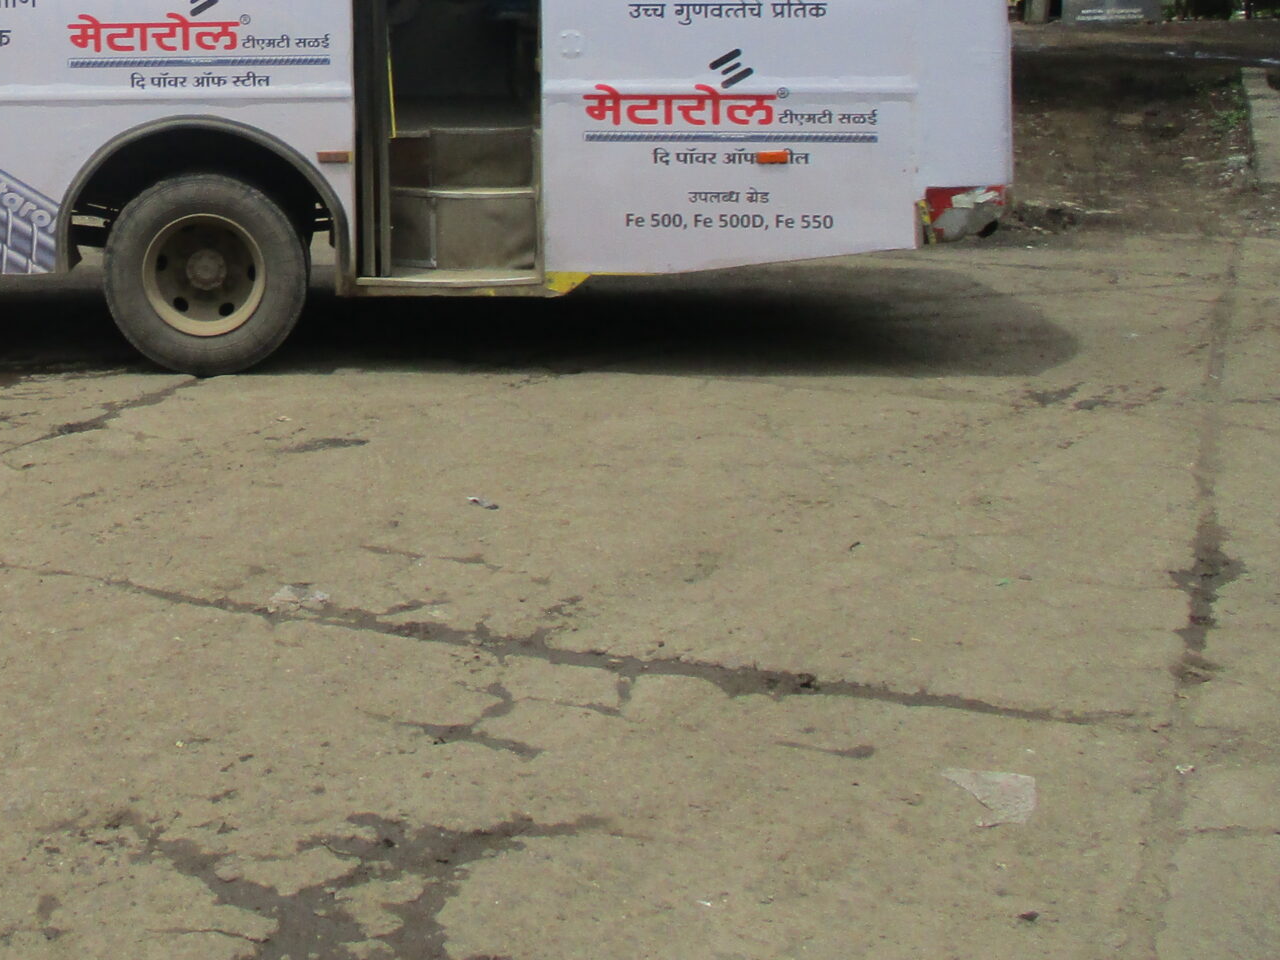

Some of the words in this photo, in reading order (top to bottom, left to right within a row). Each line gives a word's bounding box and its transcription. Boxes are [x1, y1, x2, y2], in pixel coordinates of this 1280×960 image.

[628, 3, 666, 19] उच्च
[130, 72, 145, 89] दि
[150, 72, 187, 88] पॉवर
[193, 72, 228, 87] ऑफ
[233, 71, 270, 87] स्टील
[653, 148, 670, 166] दि
[676, 148, 716, 165] पॉवर
[625, 213, 645, 228] Fe
[651, 214, 687, 230] 500,
[694, 214, 714, 228] Fe
[719, 214, 769, 231] 500D,
[775, 215, 795, 228] Fe
[801, 215, 833, 229] 550
